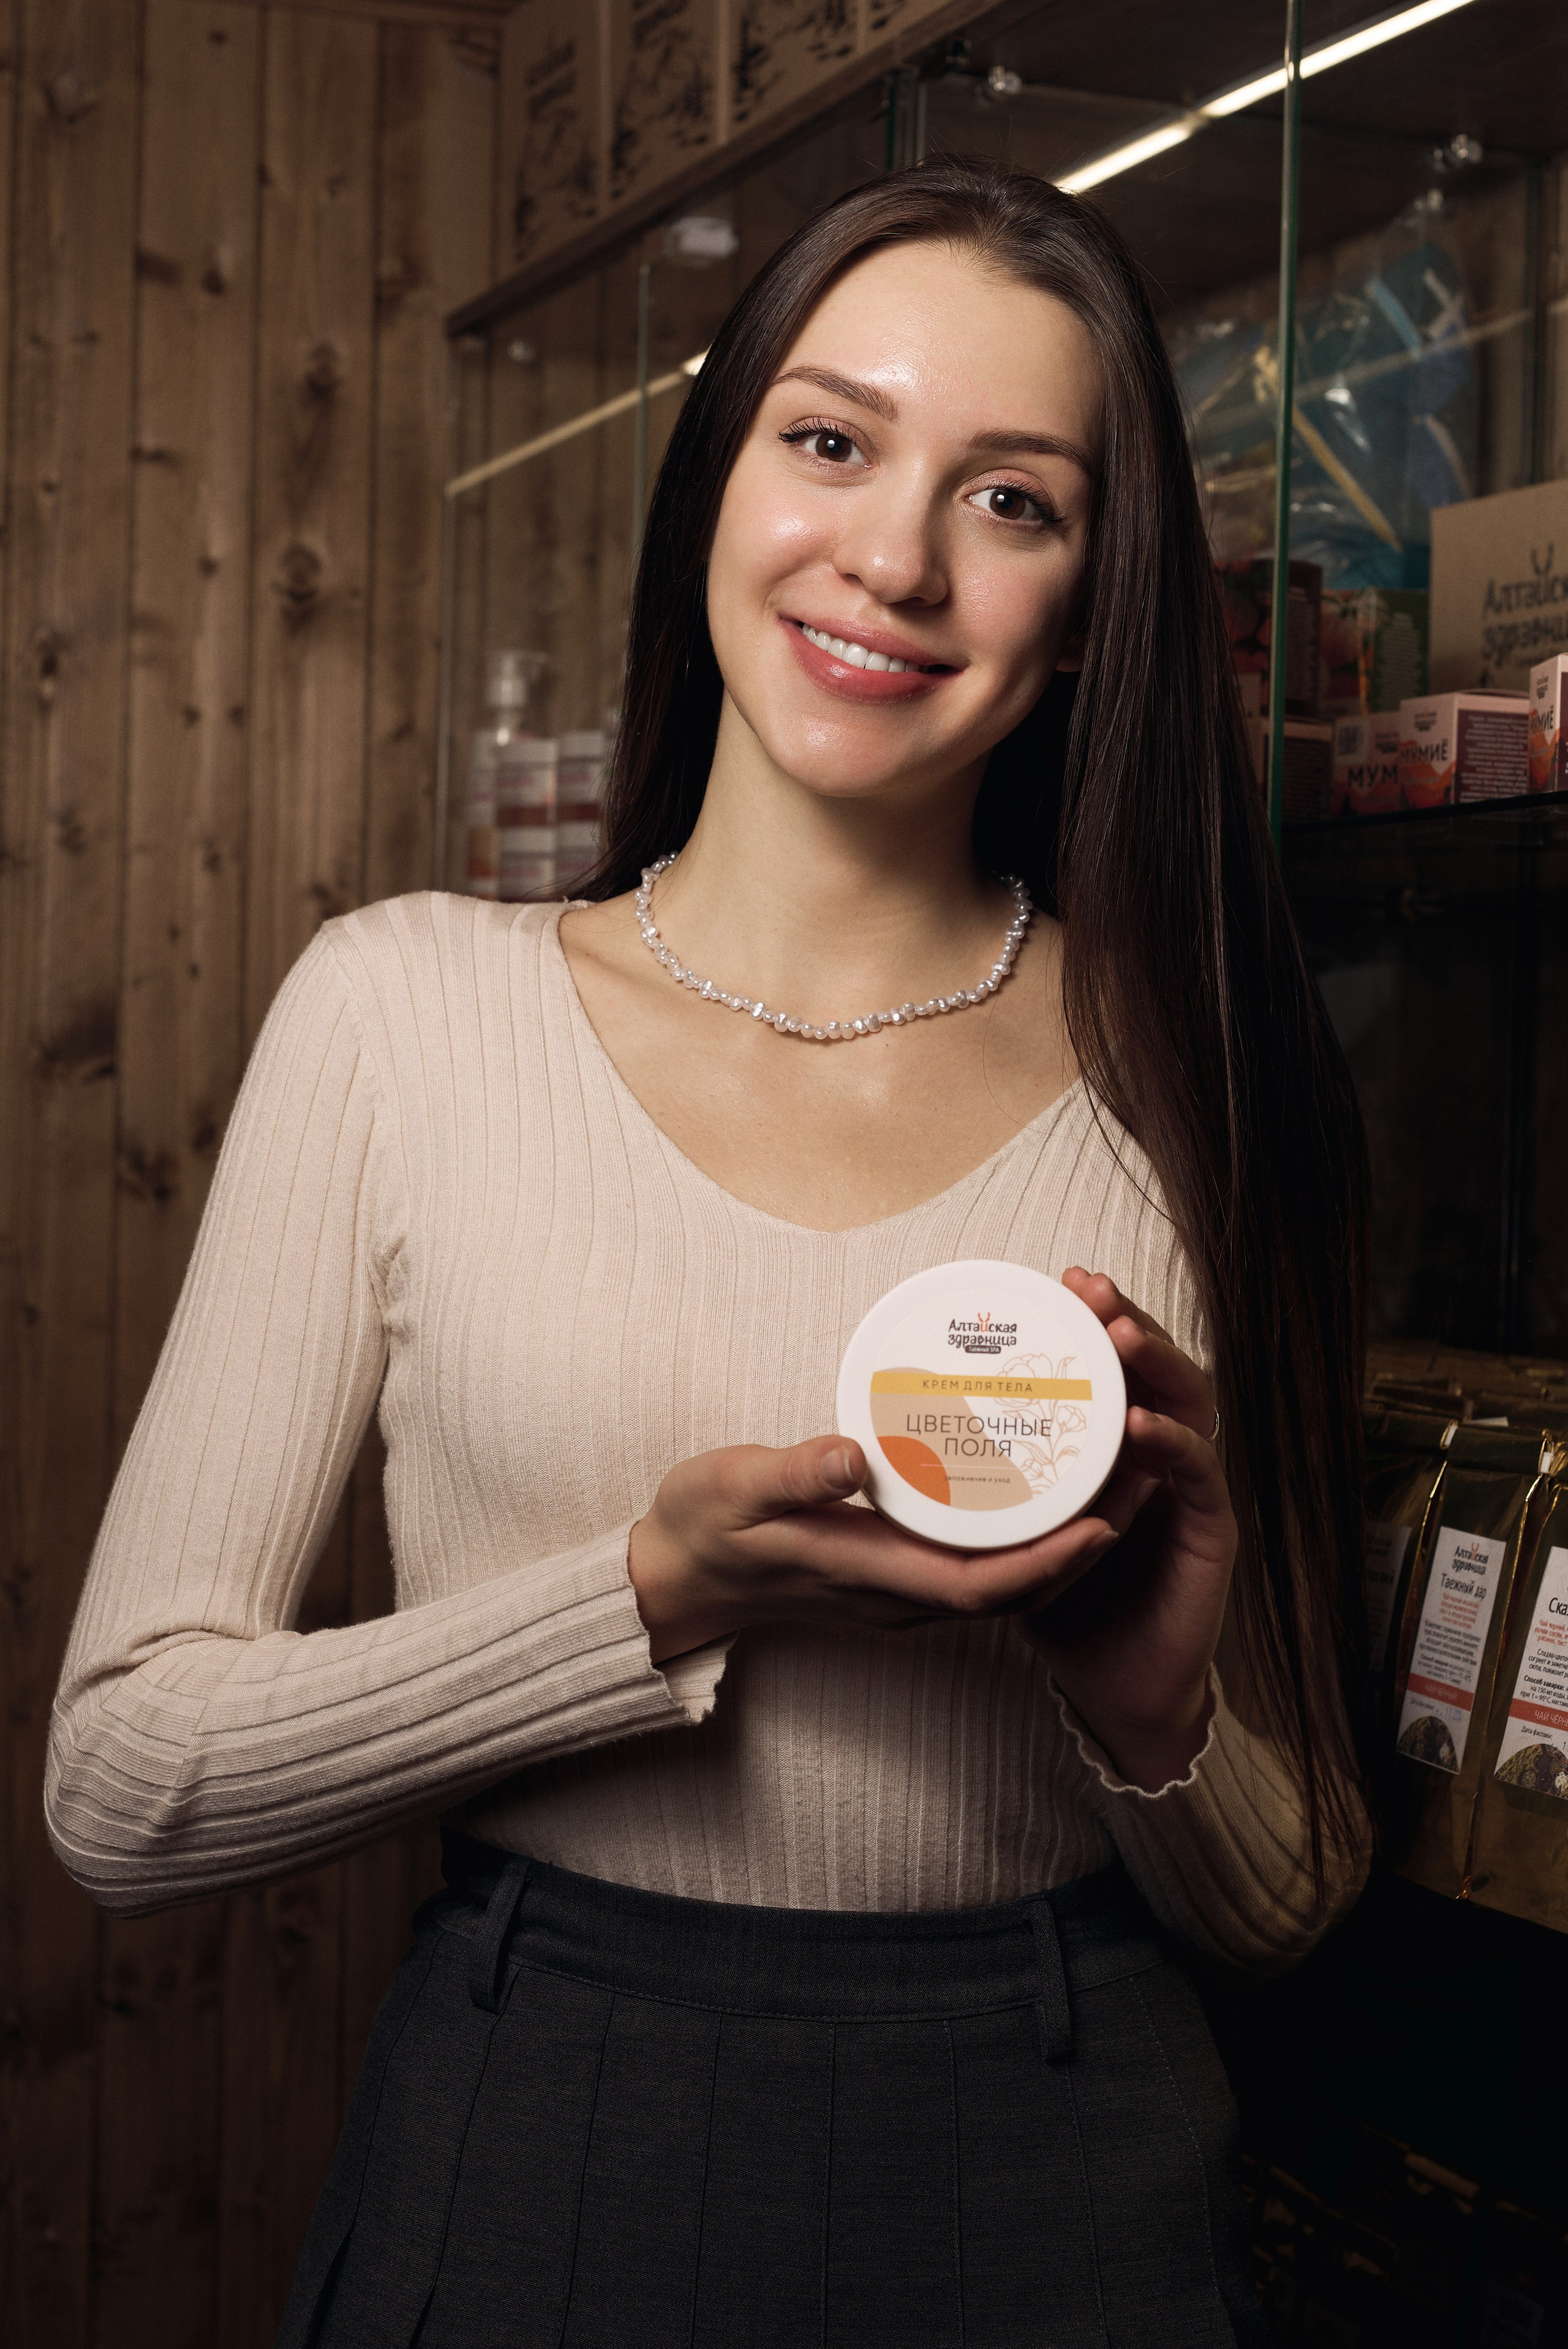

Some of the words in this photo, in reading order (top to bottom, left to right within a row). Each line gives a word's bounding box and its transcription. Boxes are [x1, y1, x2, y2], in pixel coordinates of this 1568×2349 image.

[948, 1312, 1017, 1333] Алтайская
[948, 1334, 1017, 1348] здравница
[922, 1380, 959, 1389] КРЕМ
[964, 1380, 992, 1391] ДЛЯ
[998, 1382, 1033, 1392] ТЕЛА
[907, 1414, 1052, 1437] ЦВЕТОЧНЫЕ
[944, 1438, 1011, 1458] ПОЛЯ
[1441, 1573, 1474, 1595] Таежный
[1474, 1586, 1487, 1602] дар
[1548, 1597, 1568, 1616] Ска
[1528, 1655, 1546, 1664] согреет
[1529, 1663, 1542, 1672] силы,
[1543, 1666, 1564, 1676] повышает
[1524, 1675, 1543, 1685] Способ
[1543, 1681, 1565, 1690] заварки:
[1553, 1692, 1566, 1700] воды,
[1535, 1709, 1550, 1722] ЧАЙ
[1521, 1725, 1532, 1734] Дата
[1532, 1728, 1553, 1740] фасовки:
